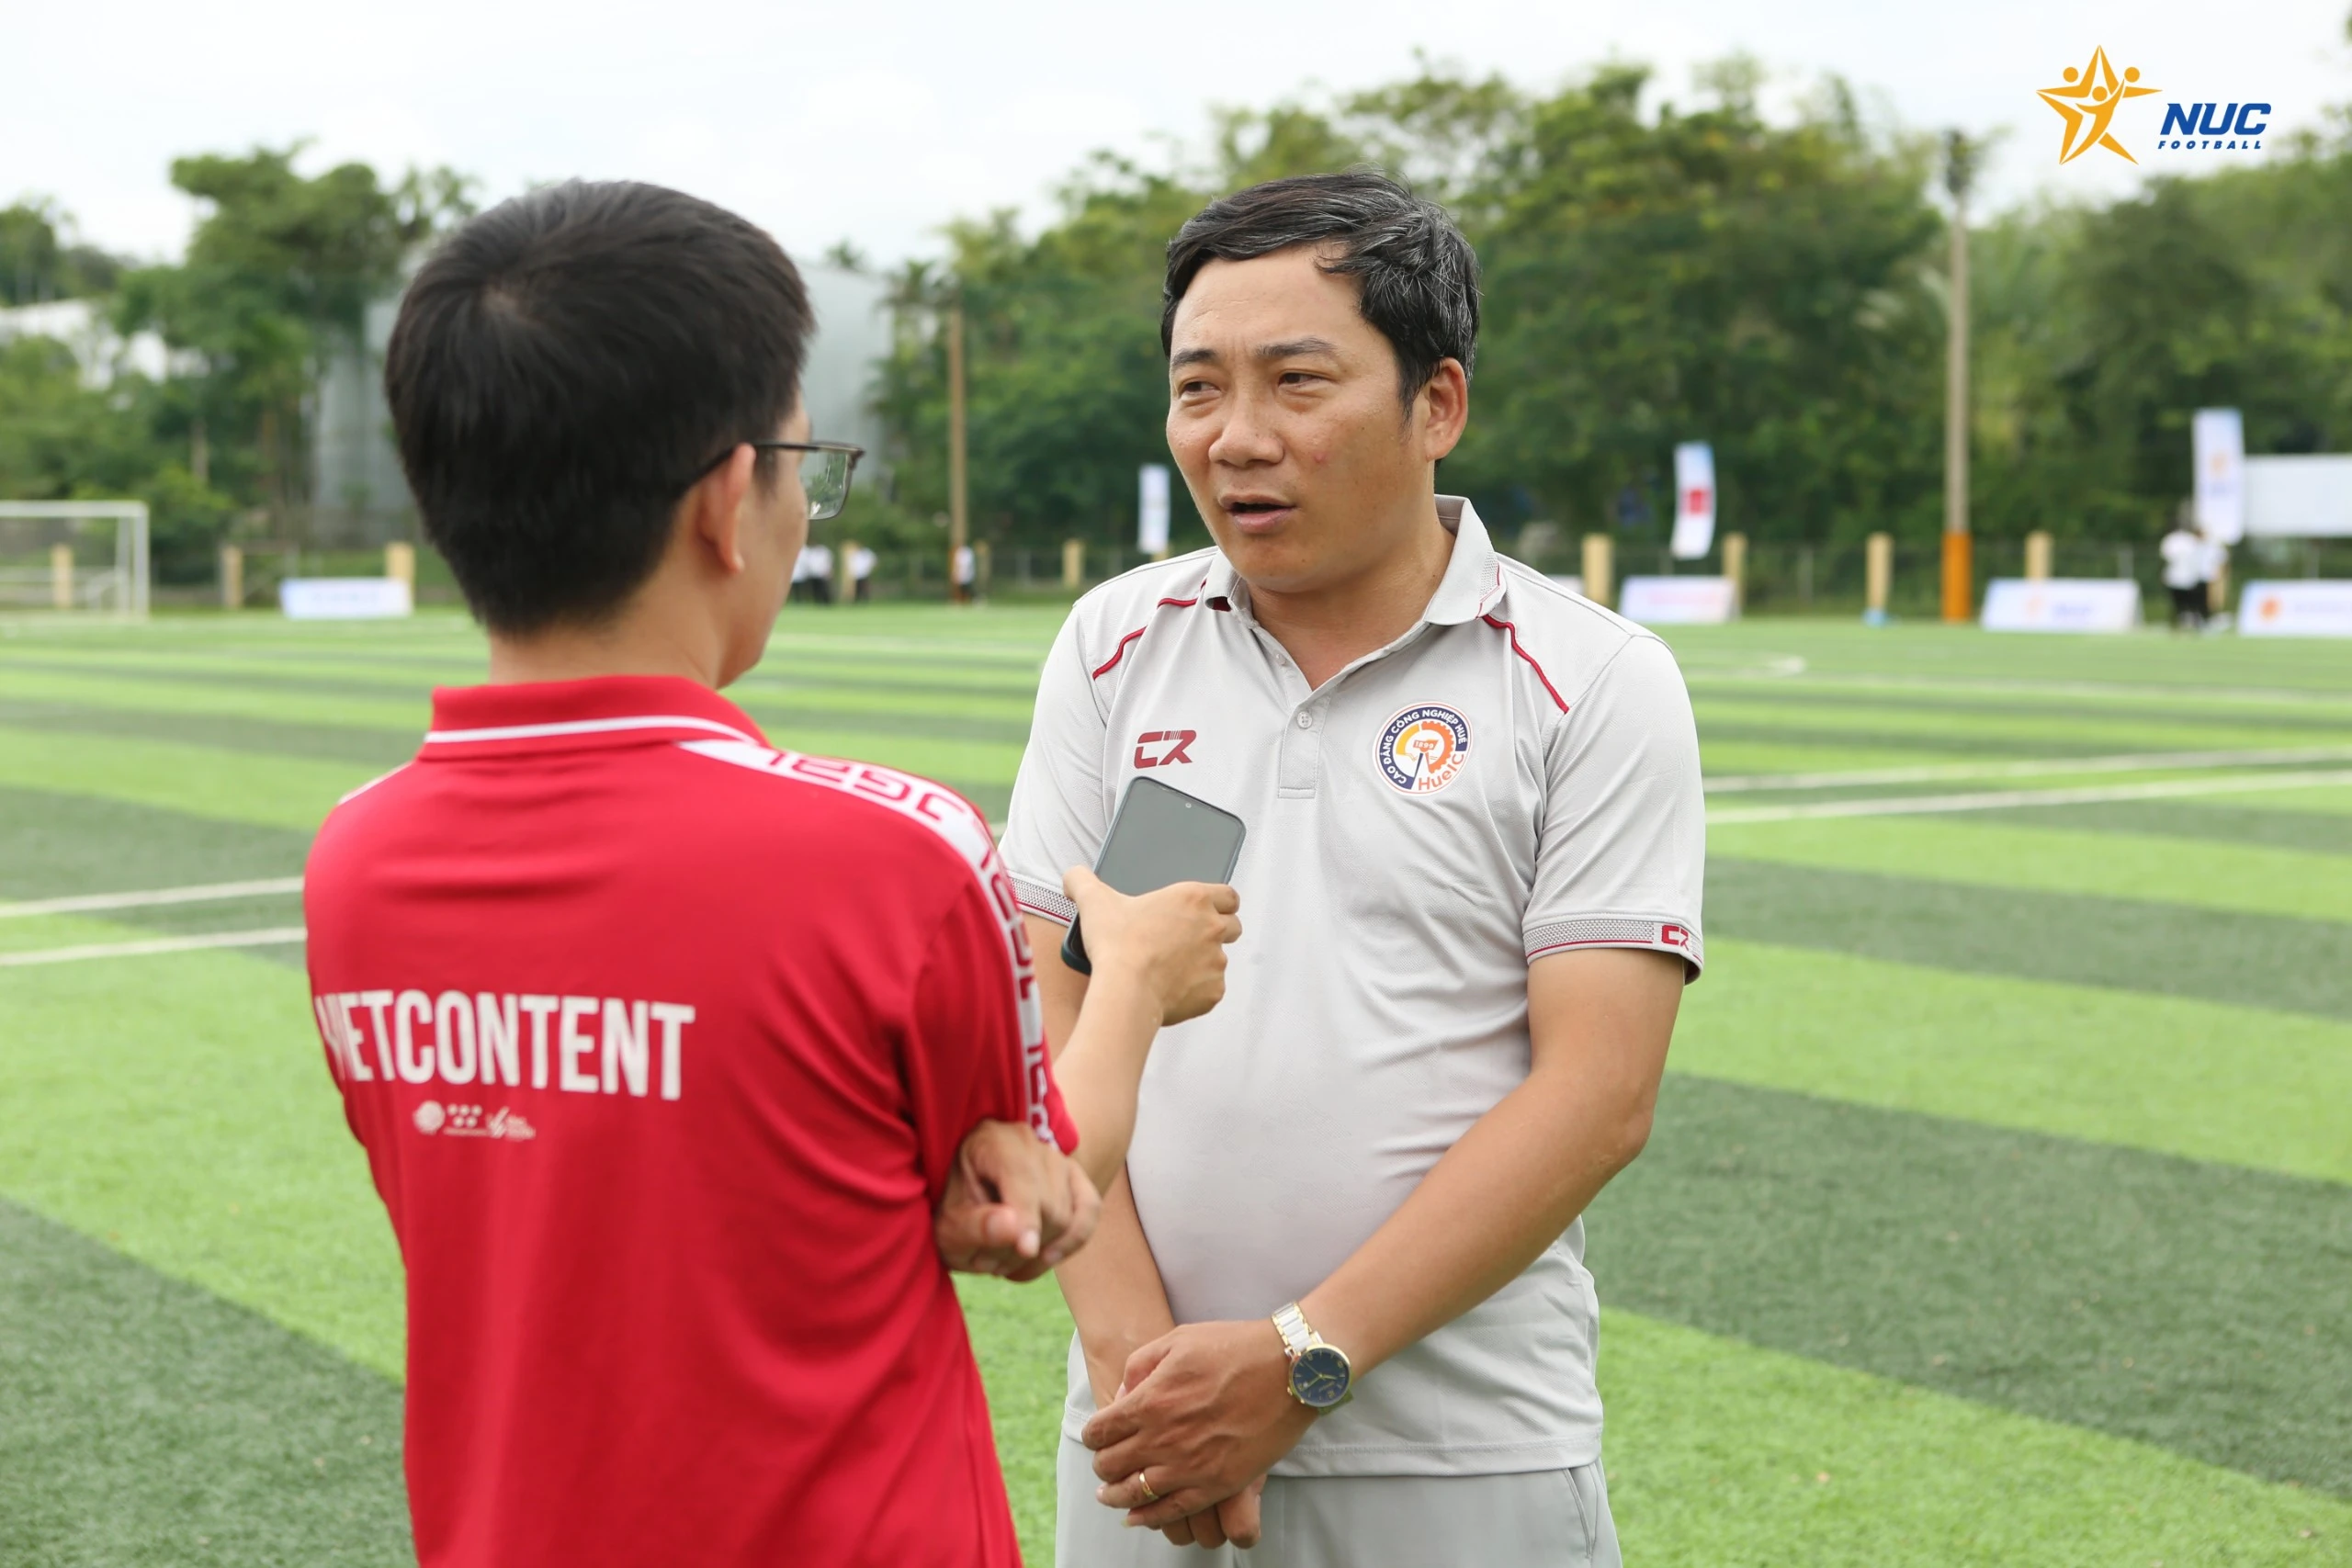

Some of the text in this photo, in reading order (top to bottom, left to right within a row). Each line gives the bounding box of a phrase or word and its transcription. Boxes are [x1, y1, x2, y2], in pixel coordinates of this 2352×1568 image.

[1391, 711, 1420, 734] CÔNG
[1421, 709, 1459, 725] NGHIỆP
[1387, 765, 1408, 784] CAO
